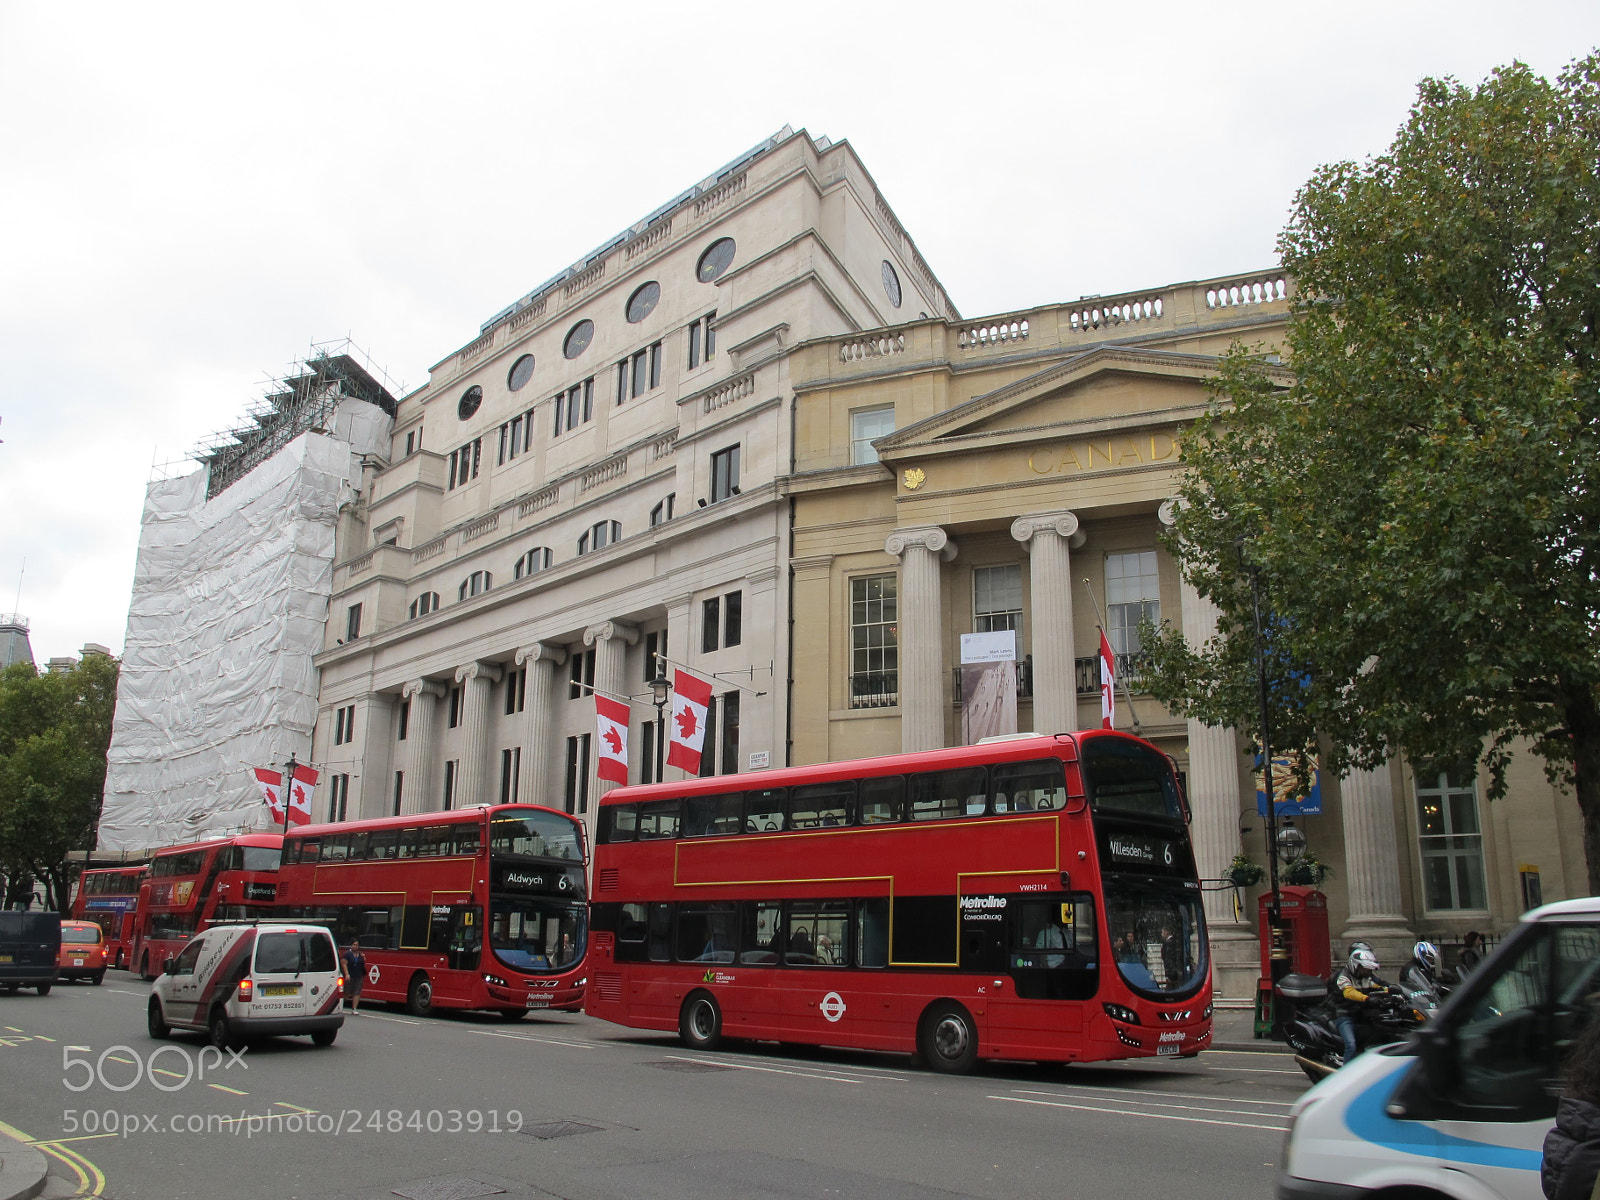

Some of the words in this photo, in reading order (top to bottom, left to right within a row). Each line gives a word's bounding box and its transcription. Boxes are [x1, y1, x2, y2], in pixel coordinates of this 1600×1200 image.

[1029, 432, 1177, 474] CANAD
[1164, 843, 1172, 865] 6
[507, 873, 543, 886] Aldwych
[558, 875, 567, 890] 6
[960, 895, 1007, 909] Metroline
[1159, 1030, 1186, 1042] Metroline
